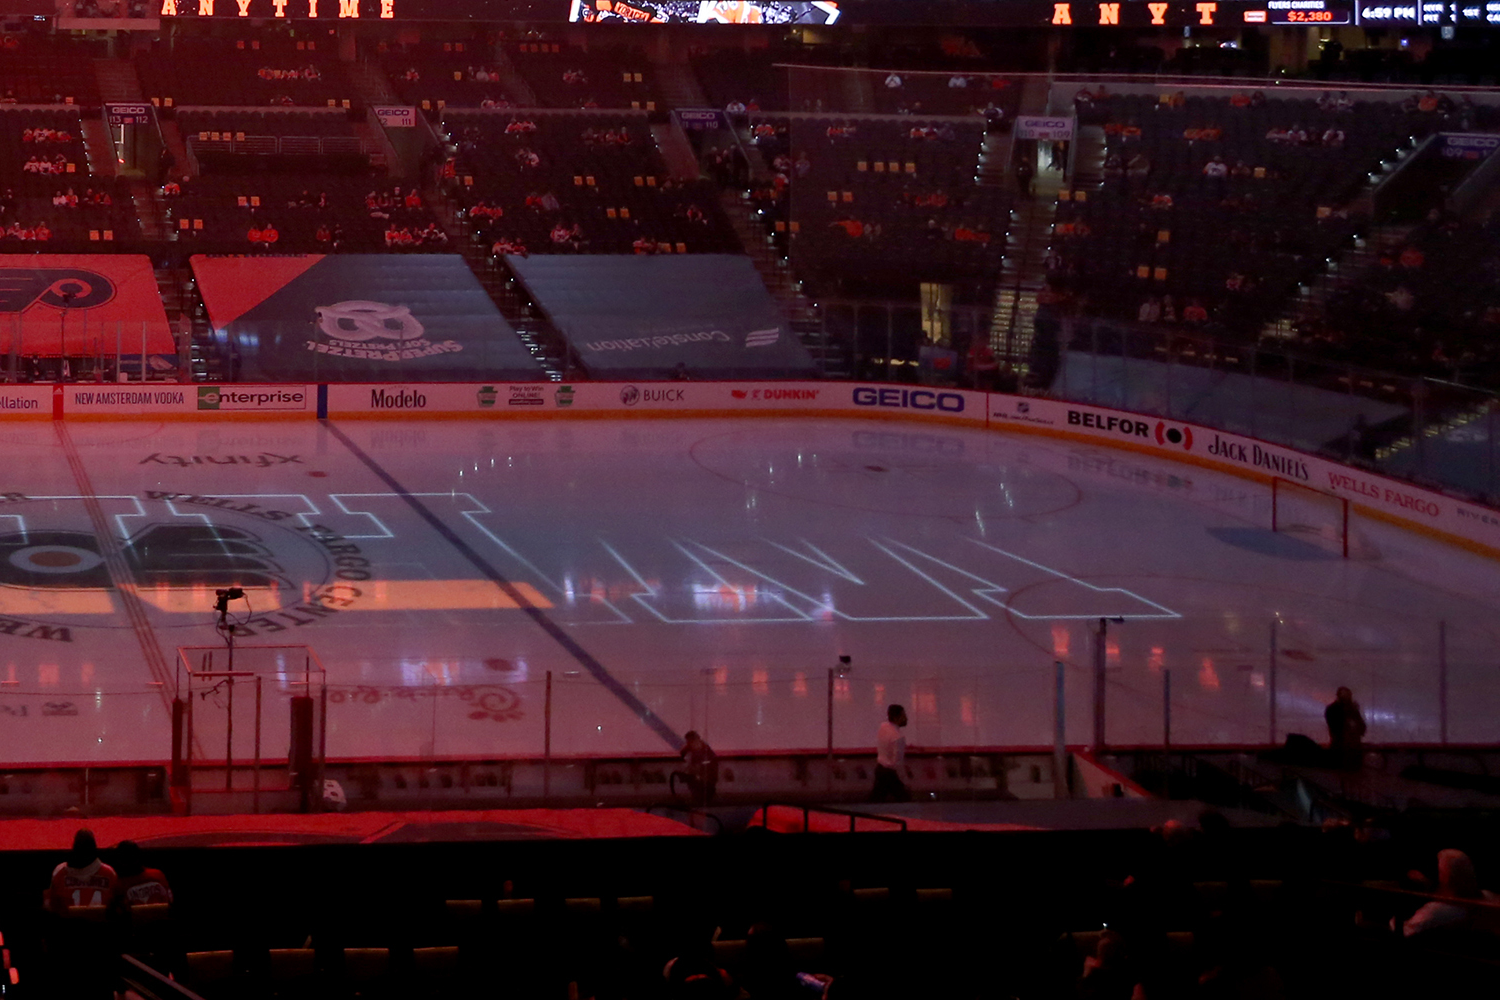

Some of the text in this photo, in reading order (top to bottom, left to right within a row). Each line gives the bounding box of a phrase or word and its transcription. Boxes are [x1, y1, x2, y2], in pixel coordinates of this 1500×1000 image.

[1268, 1, 1325, 10] FLYERS CHARITIES
[1422, 3, 1445, 13] NYR
[1052, 2, 1217, 26] ANYT
[1287, 10, 1333, 23] $2,380
[1361, 6, 1416, 20] 6:59 PM
[1422, 13, 1440, 23] PIT
[112, 107, 146, 115] GEICO
[681, 112, 716, 120] GEICO
[109, 115, 149, 124] 113 112
[1025, 120, 1066, 128] GEICO
[75, 392, 184, 405] NEW AMSTERDAM VODKA
[204, 391, 304, 406] enterprise
[371, 389, 427, 408] Modelo
[643, 389, 685, 402] BUICK
[763, 389, 819, 401] DUNKIN'
[853, 387, 965, 413] GEICO
[1067, 410, 1148, 438] BELFOR
[1208, 433, 1248, 463] JACK
[138, 453, 304, 468] xfinity
[1328, 472, 1440, 518] WELLS FARGO
[145, 490, 292, 521] WELLS
[295, 523, 371, 581] FARGO
